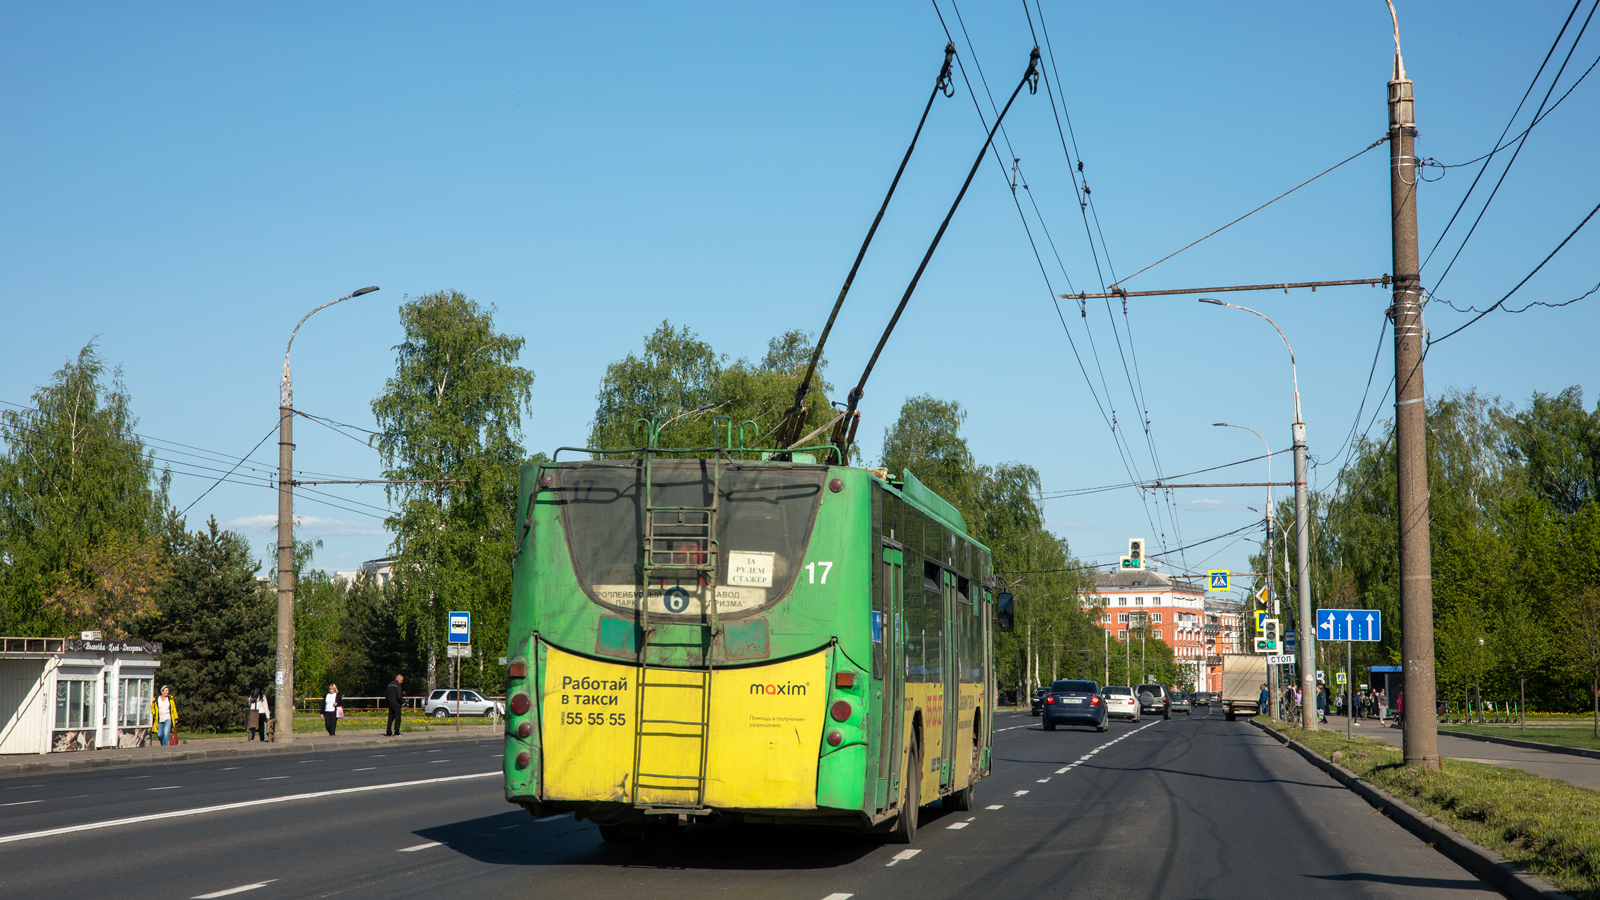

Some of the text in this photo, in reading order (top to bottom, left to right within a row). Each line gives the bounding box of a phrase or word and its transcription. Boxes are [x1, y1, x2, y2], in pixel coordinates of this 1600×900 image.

[572, 479, 595, 501] 17
[736, 566, 765, 575] РУЛЕМ
[805, 561, 833, 584] 17
[669, 590, 684, 610] 6
[713, 591, 740, 599] АВОД
[562, 676, 627, 691] Работай
[561, 695, 618, 705] в такси
